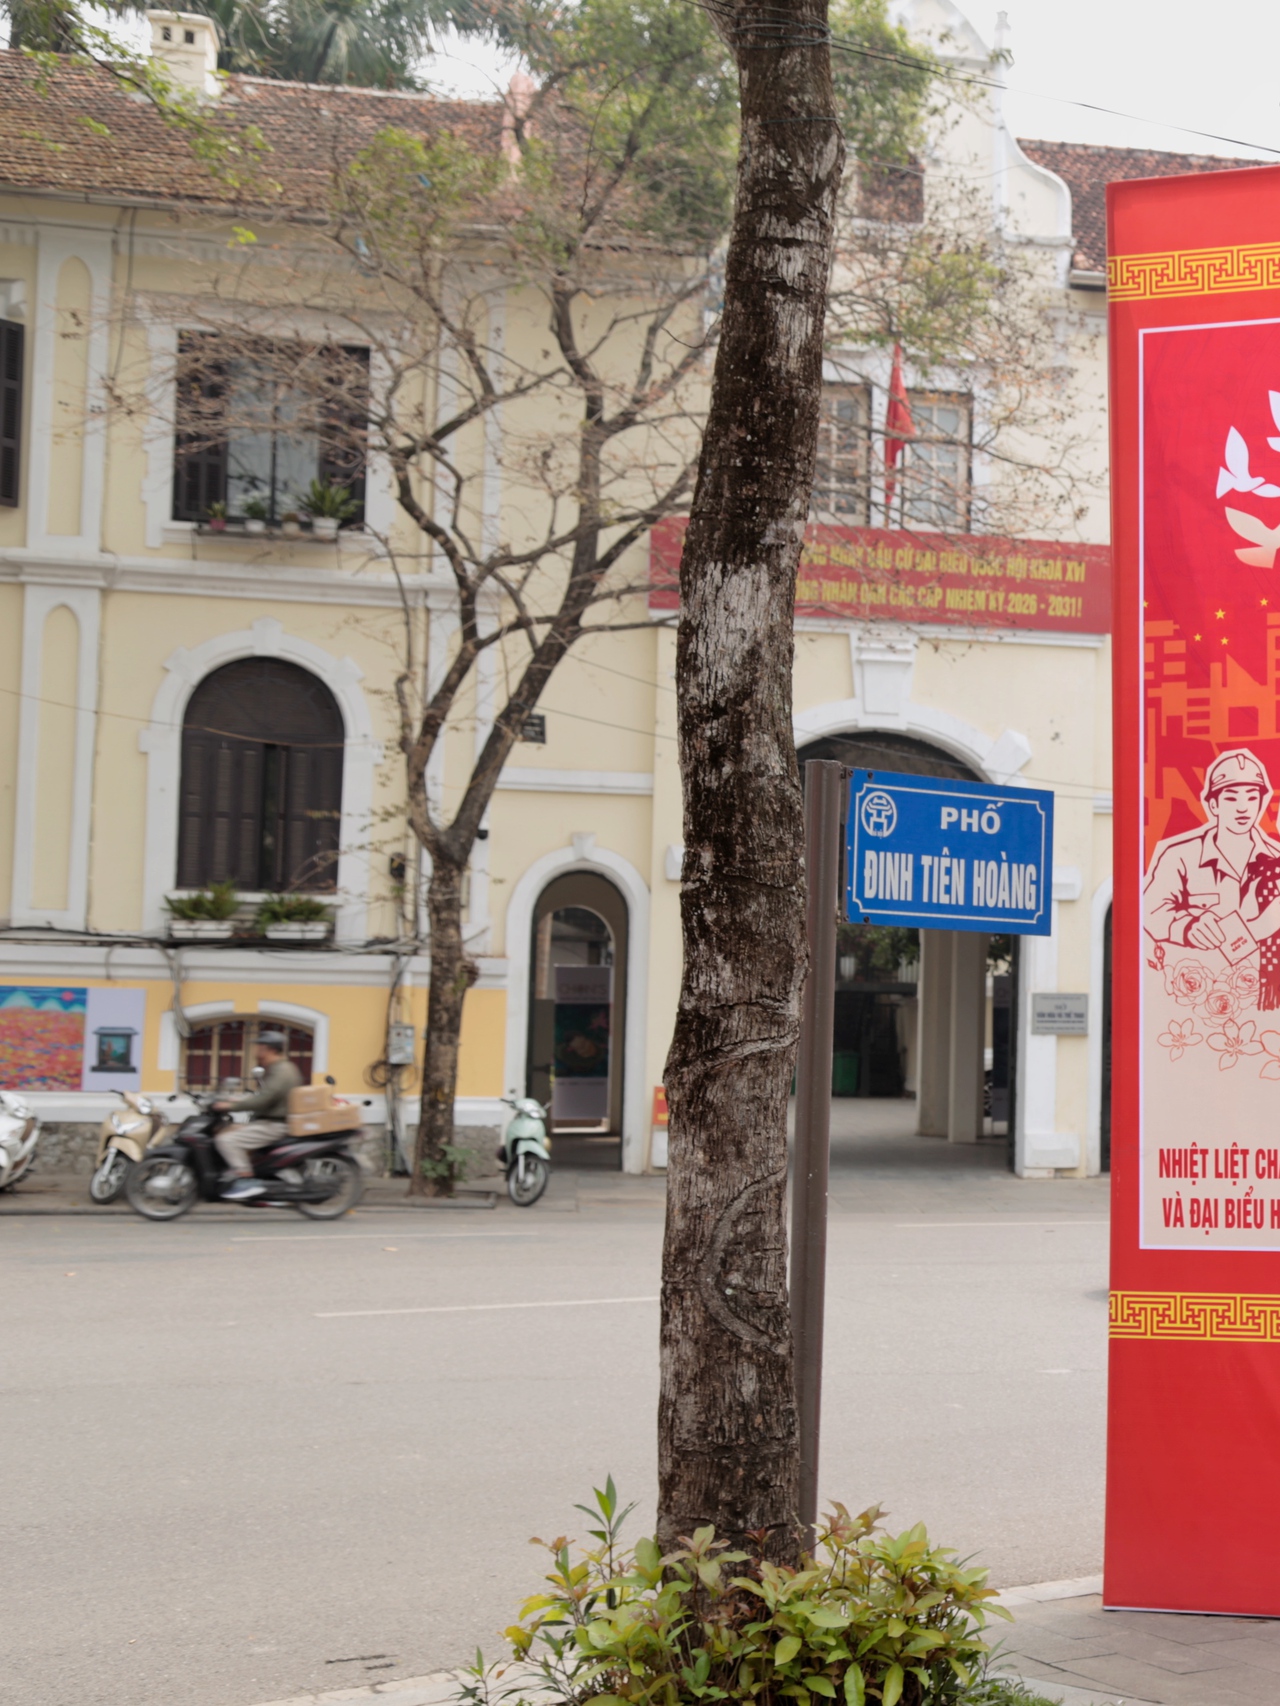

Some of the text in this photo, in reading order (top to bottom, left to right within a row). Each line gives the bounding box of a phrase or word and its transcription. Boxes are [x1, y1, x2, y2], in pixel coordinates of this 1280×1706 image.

[1065, 561, 1086, 582] XVI
[1007, 593, 1037, 615] 2026
[1048, 595, 1082, 618] 2031!
[940, 802, 1004, 834] PHỐ
[864, 847, 1037, 910] ĐINH TIÊN HOÀNG
[1158, 1142, 1209, 1185] NHIỆT
[1214, 1142, 1249, 1186] LIỆT
[1162, 1191, 1184, 1228] VÀ
[1190, 1198, 1218, 1235] ĐẠI
[1224, 1186, 1264, 1229] BIỂU
